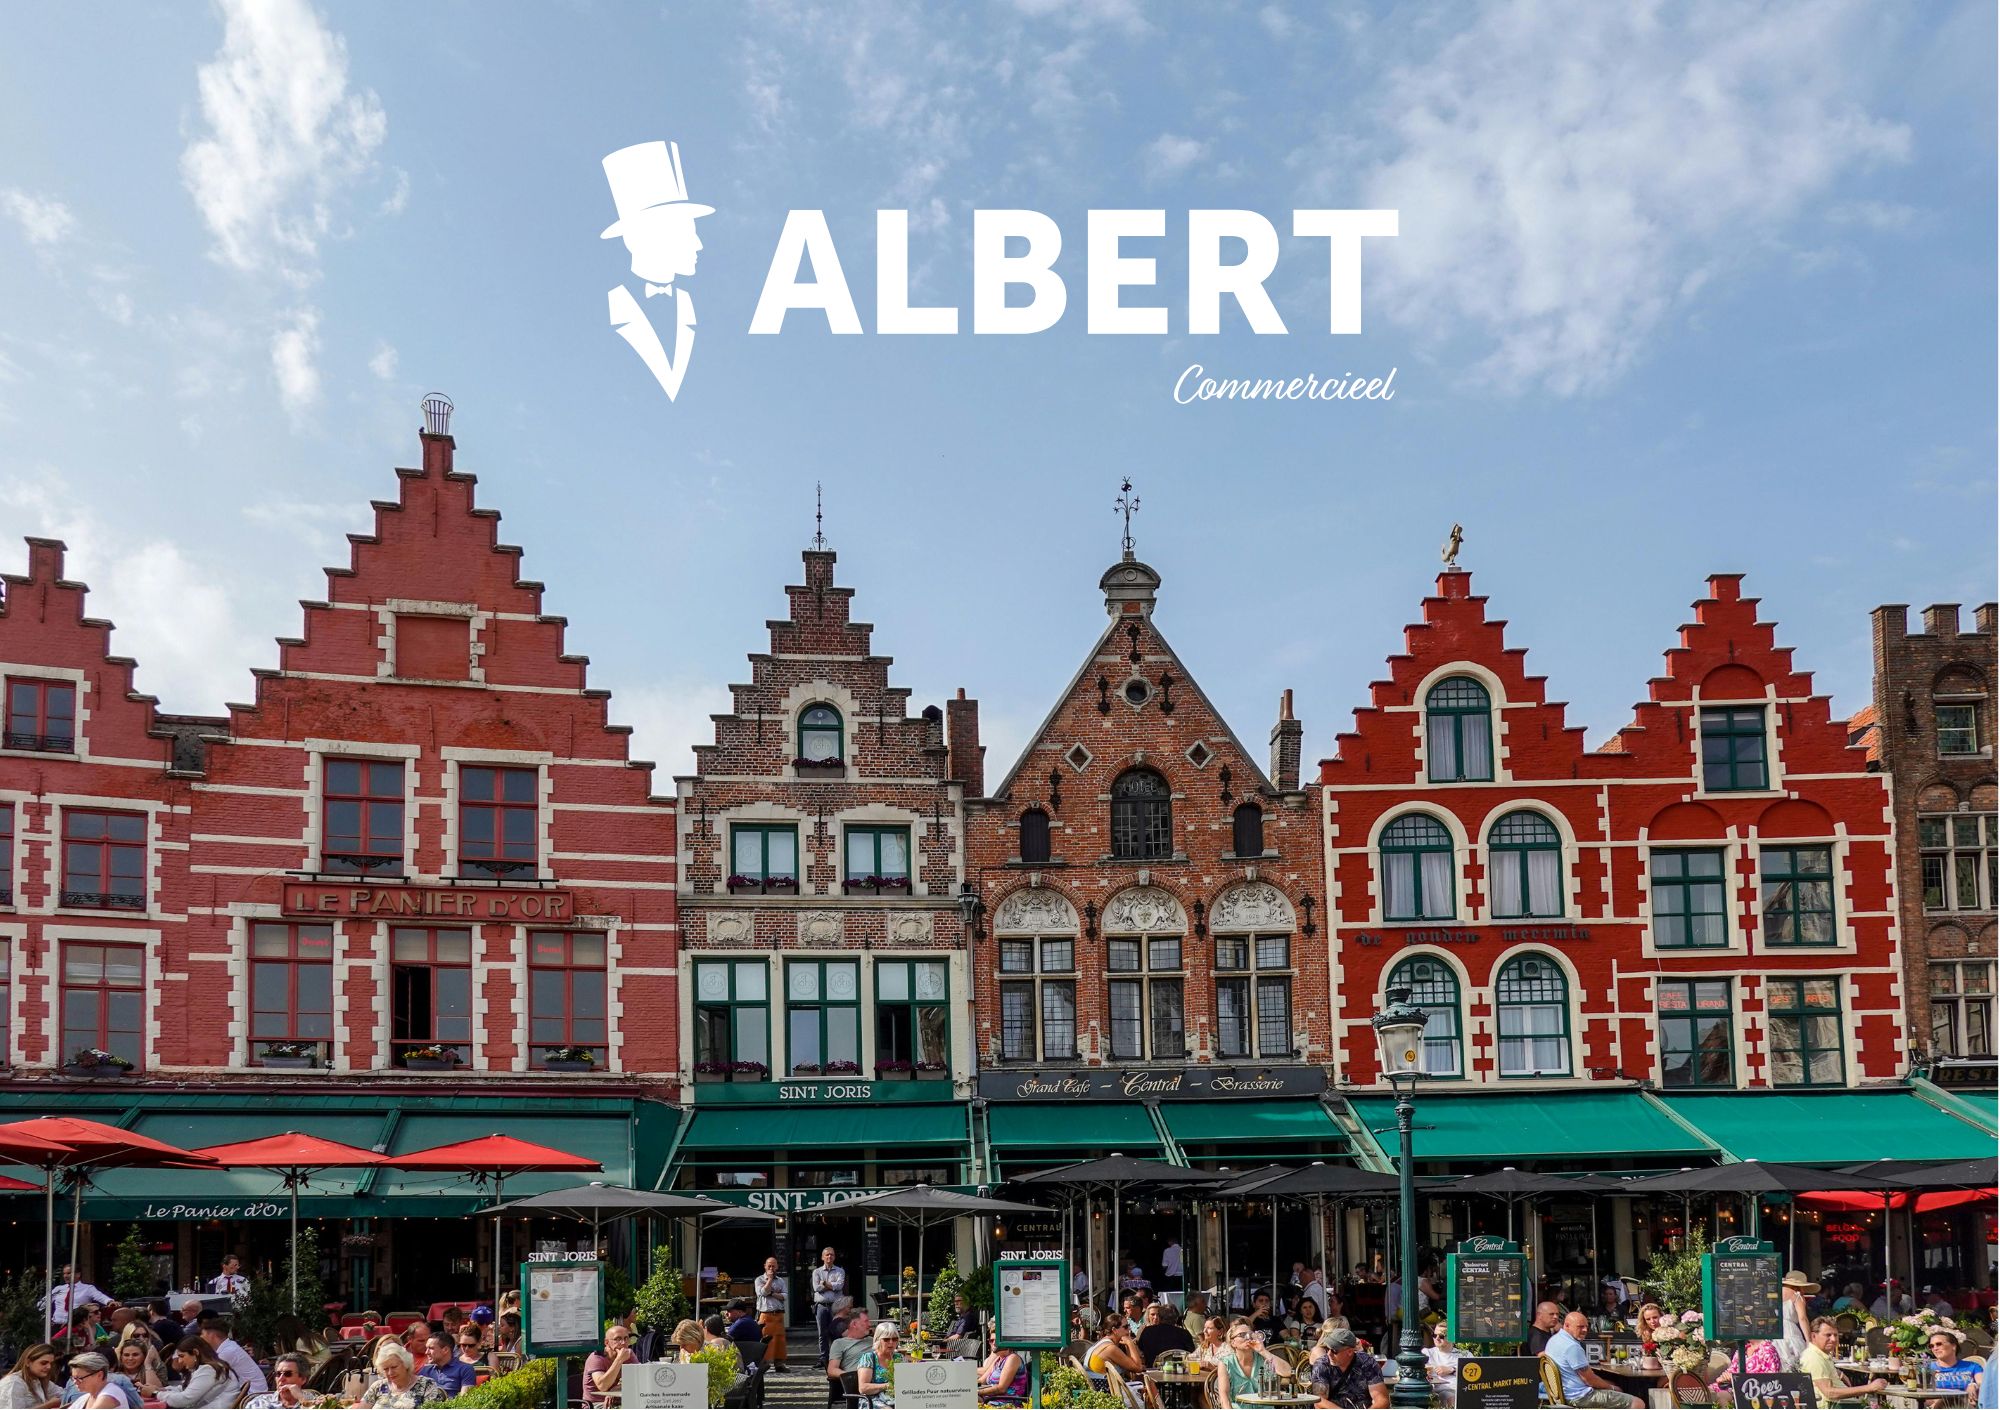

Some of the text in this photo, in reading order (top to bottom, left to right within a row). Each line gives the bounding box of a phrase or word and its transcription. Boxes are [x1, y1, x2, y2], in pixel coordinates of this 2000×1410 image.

[295, 889, 566, 918] LE PANIER D'OR
[779, 1085, 871, 1099] SINT JORIS
[1016, 1079, 1059, 1097] Grand
[1121, 1072, 1182, 1096] Central
[1210, 1076, 1284, 1091] Brasserie
[146, 1202, 288, 1218] Le Panier d'Or
[1016, 1224, 1061, 1232] CENTRAL
[1474, 1238, 1504, 1253] Central
[1728, 1238, 1759, 1253] Central
[528, 1250, 598, 1262] SINT JORIS
[1000, 1249, 1063, 1260] SINT JORIS
[1467, 1377, 1529, 1391] CENTRAL MARKT MENU
[1741, 1377, 1783, 1400] Beer
